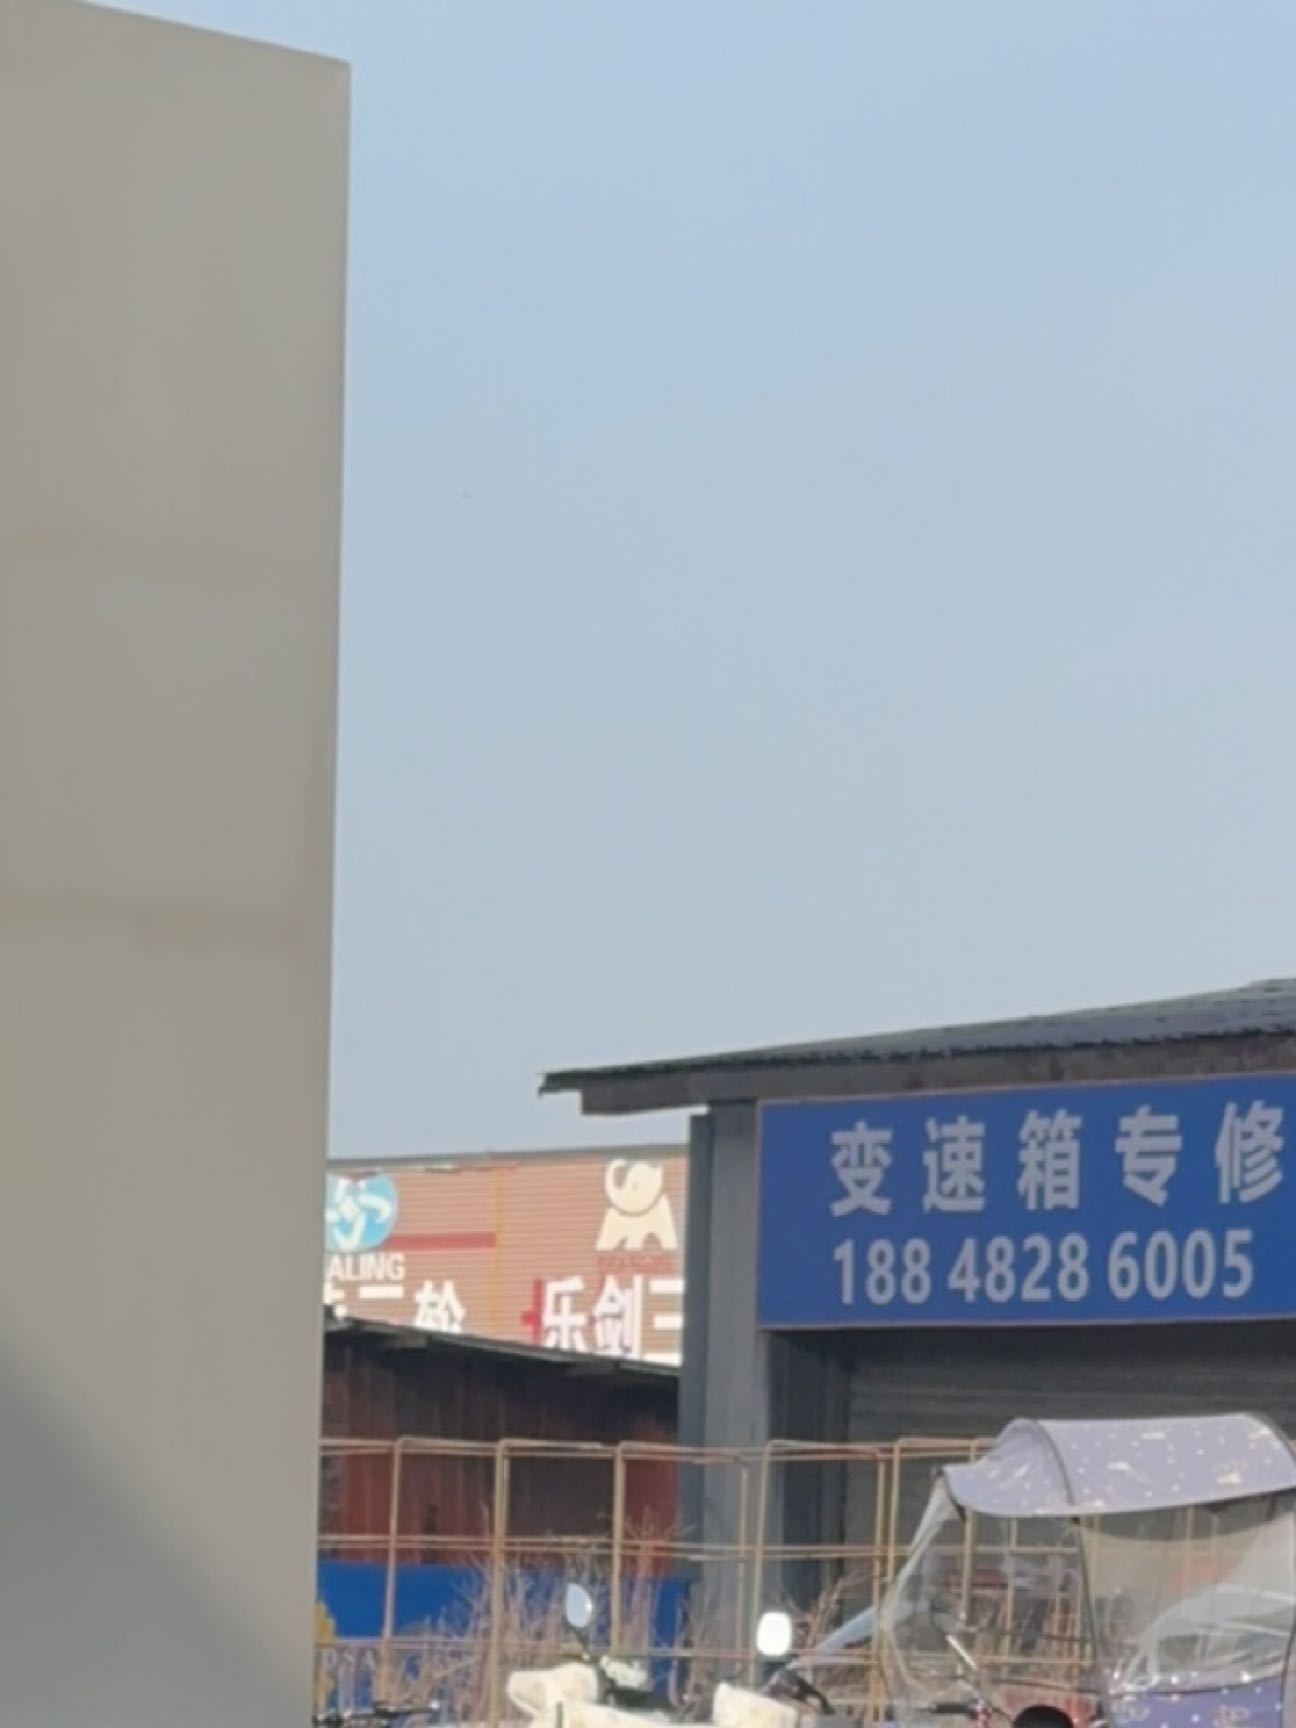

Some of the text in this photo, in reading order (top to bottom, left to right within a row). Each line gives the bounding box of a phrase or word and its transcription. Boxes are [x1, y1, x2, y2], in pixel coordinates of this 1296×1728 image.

[830, 1101, 1284, 1217] 变速箱专修
[834, 1229, 1252, 1305] 188 4828 6005
